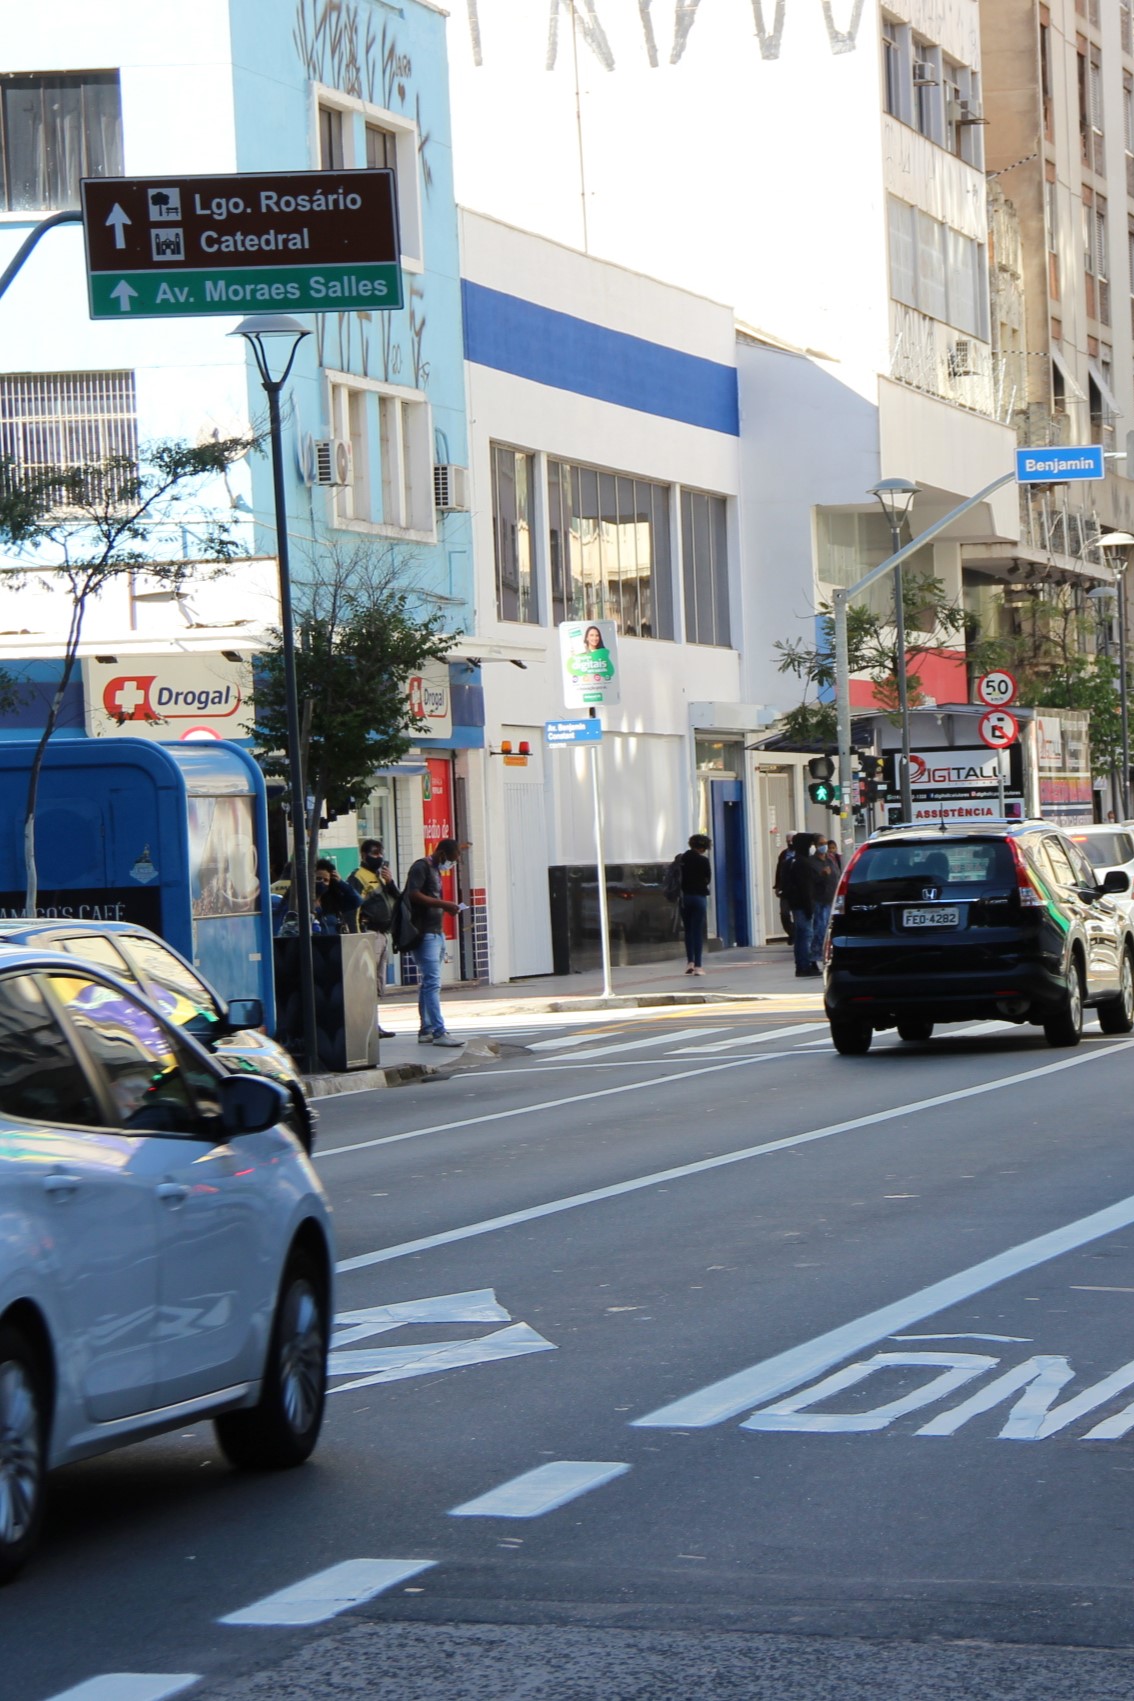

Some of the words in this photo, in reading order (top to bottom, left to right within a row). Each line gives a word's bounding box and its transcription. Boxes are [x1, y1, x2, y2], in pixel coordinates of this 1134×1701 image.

[194, 193, 252, 220] Lgo.
[260, 189, 362, 214] Rosário
[200, 228, 310, 253] Catedral
[155, 282, 194, 304] Av.
[205, 280, 301, 302] Moraes
[309, 276, 388, 298] Salles
[1025, 457, 1094, 474] Benjamin
[157, 685, 231, 710] Drogal
[424, 688, 445, 711] Drogal
[986, 680, 1009, 696] 50
[916, 807, 993, 819] ASSISTÊNCIA
[0, 906, 73, 919] AMGO'S
